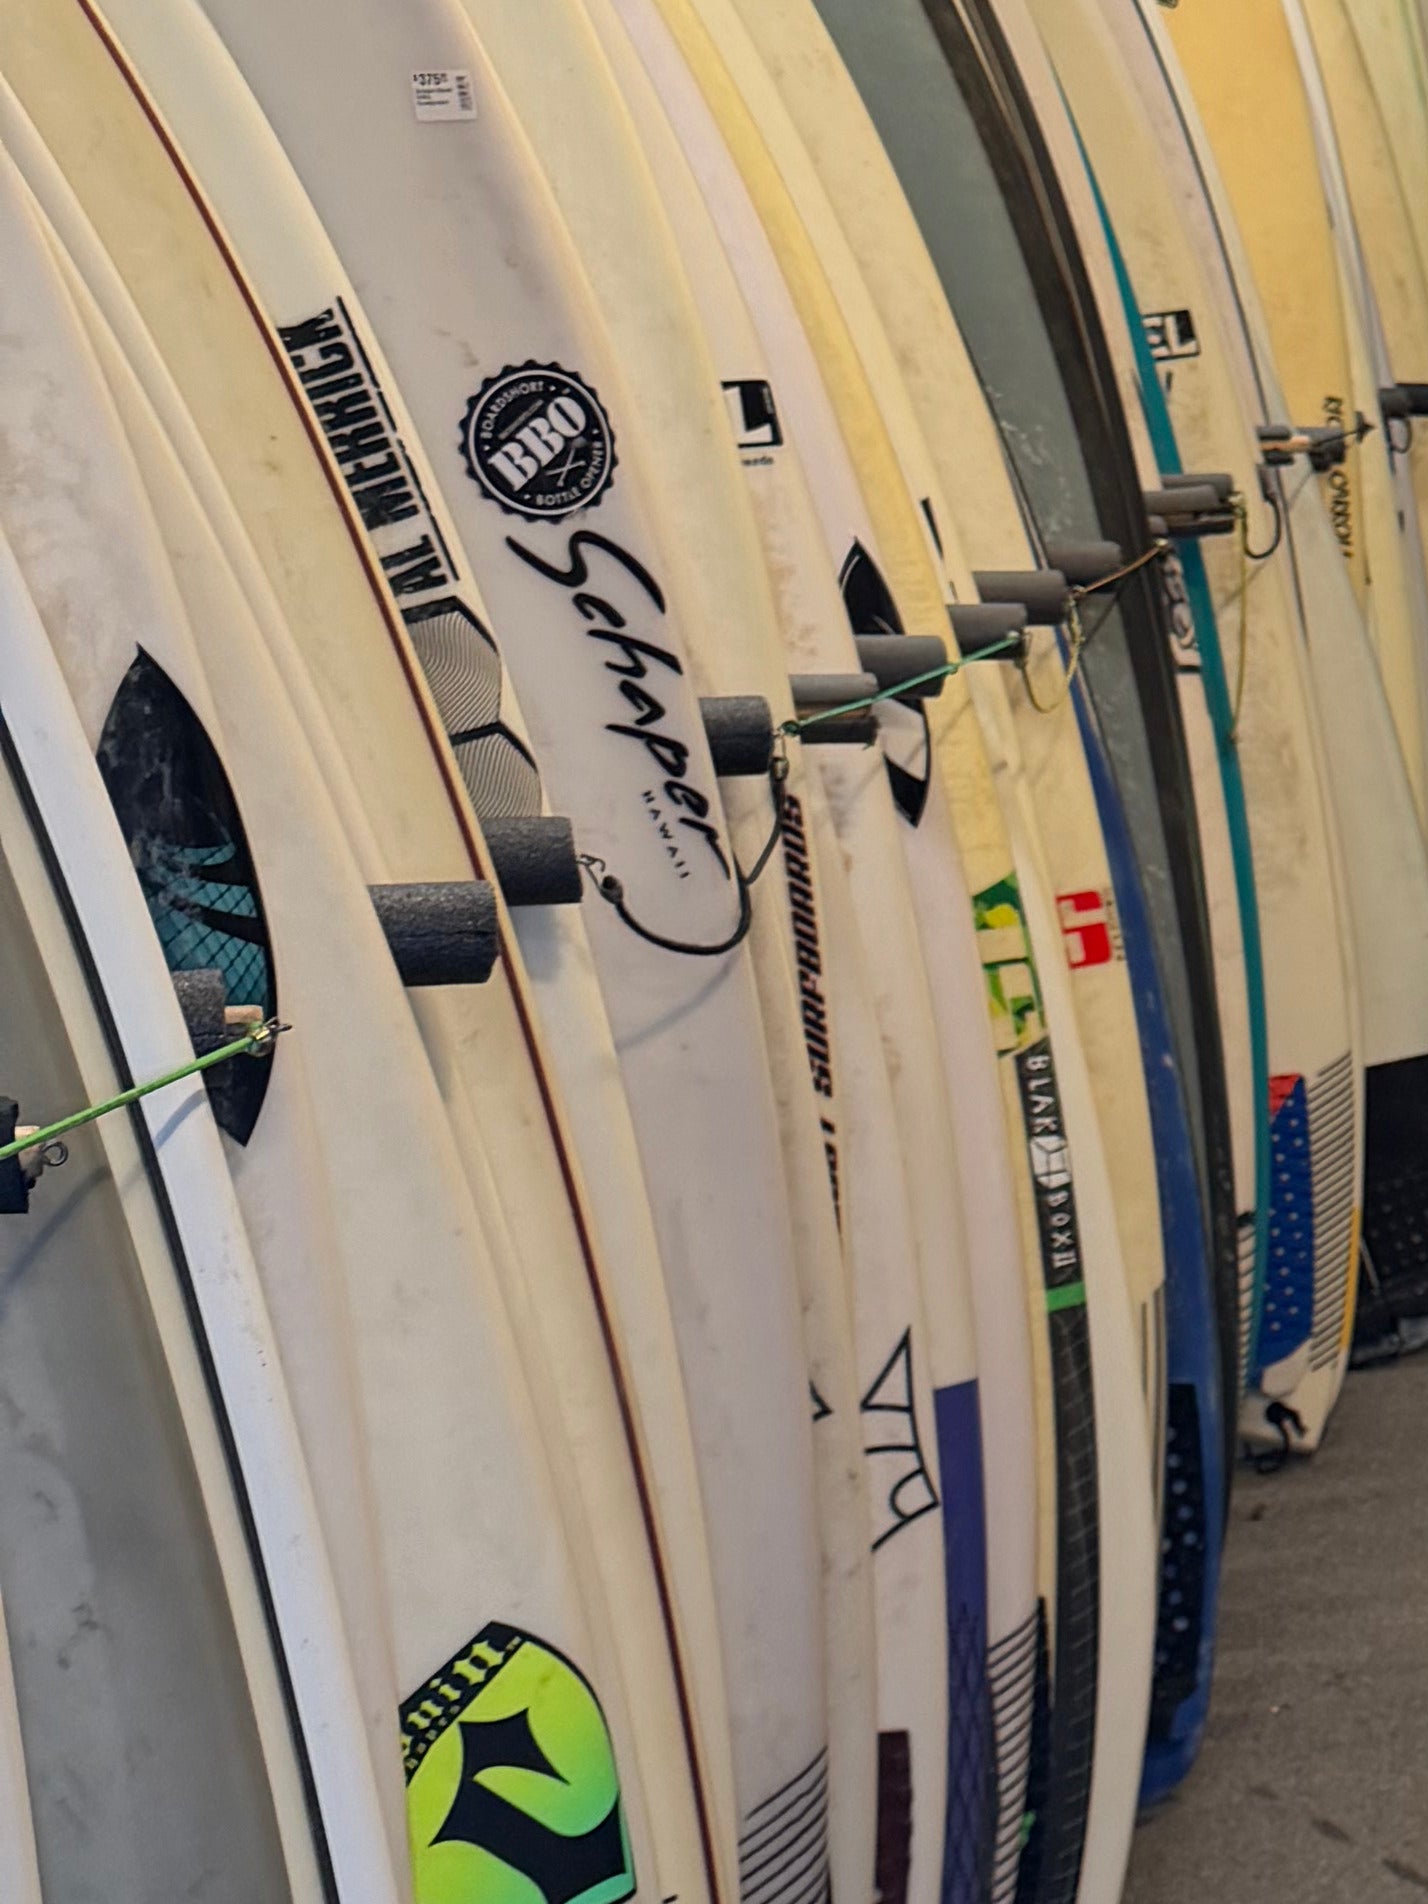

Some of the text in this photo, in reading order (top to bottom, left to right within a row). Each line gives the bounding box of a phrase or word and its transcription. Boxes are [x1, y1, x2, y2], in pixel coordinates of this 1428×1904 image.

[277, 308, 448, 596] AL MERRICK
[487, 396, 586, 492] BBO
[506, 530, 733, 880] Schaper
[642, 789, 692, 881] HAWAII
[781, 794, 833, 1098] SURFBOARDS
[1026, 1054, 1060, 1135] BLAK
